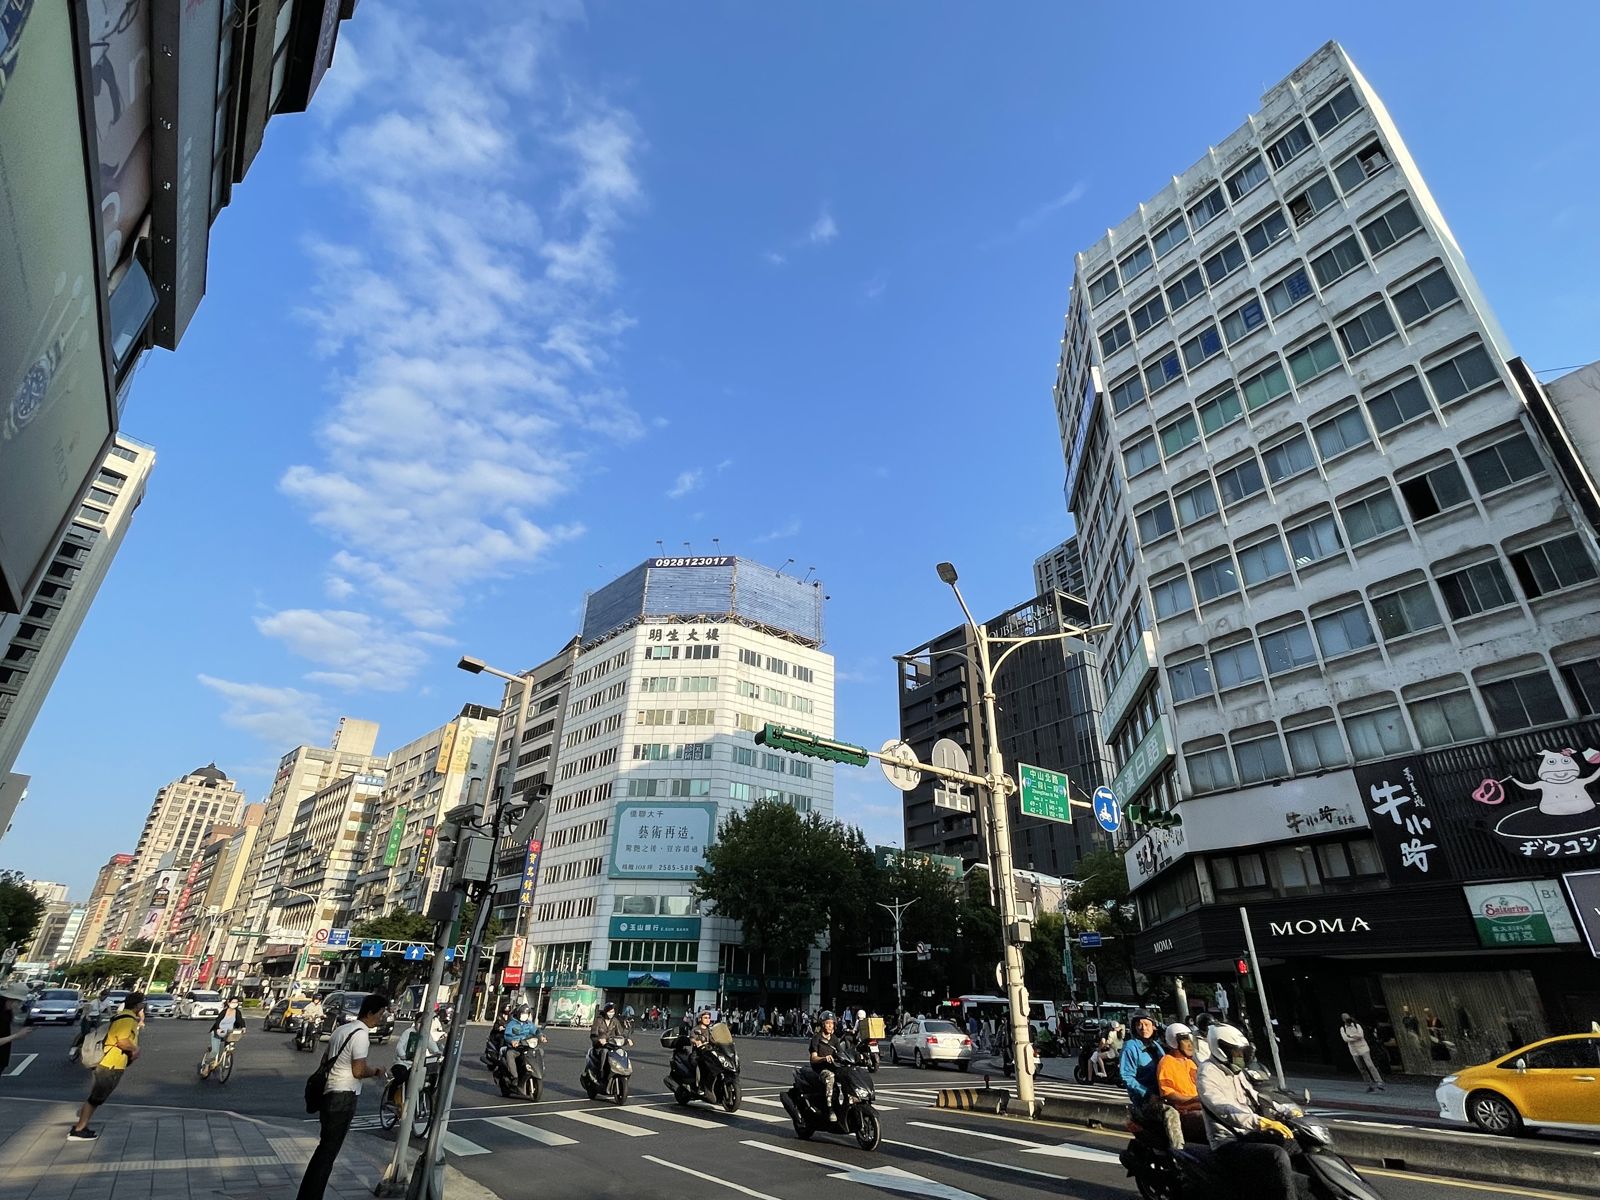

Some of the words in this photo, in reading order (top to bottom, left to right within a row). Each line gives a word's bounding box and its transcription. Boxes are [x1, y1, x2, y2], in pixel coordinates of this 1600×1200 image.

[655, 557, 727, 567] 0928123017
[648, 628, 720, 642] 明生大樓
[1030, 769, 1059, 785] 中山北路
[1370, 780, 1438, 873] 牛小路
[1485, 904, 1530, 916] Saizeriya
[629, 923, 659, 931] 玉山銀行
[1269, 917, 1372, 937] MOMA
[1153, 938, 1173, 954] MOMA
